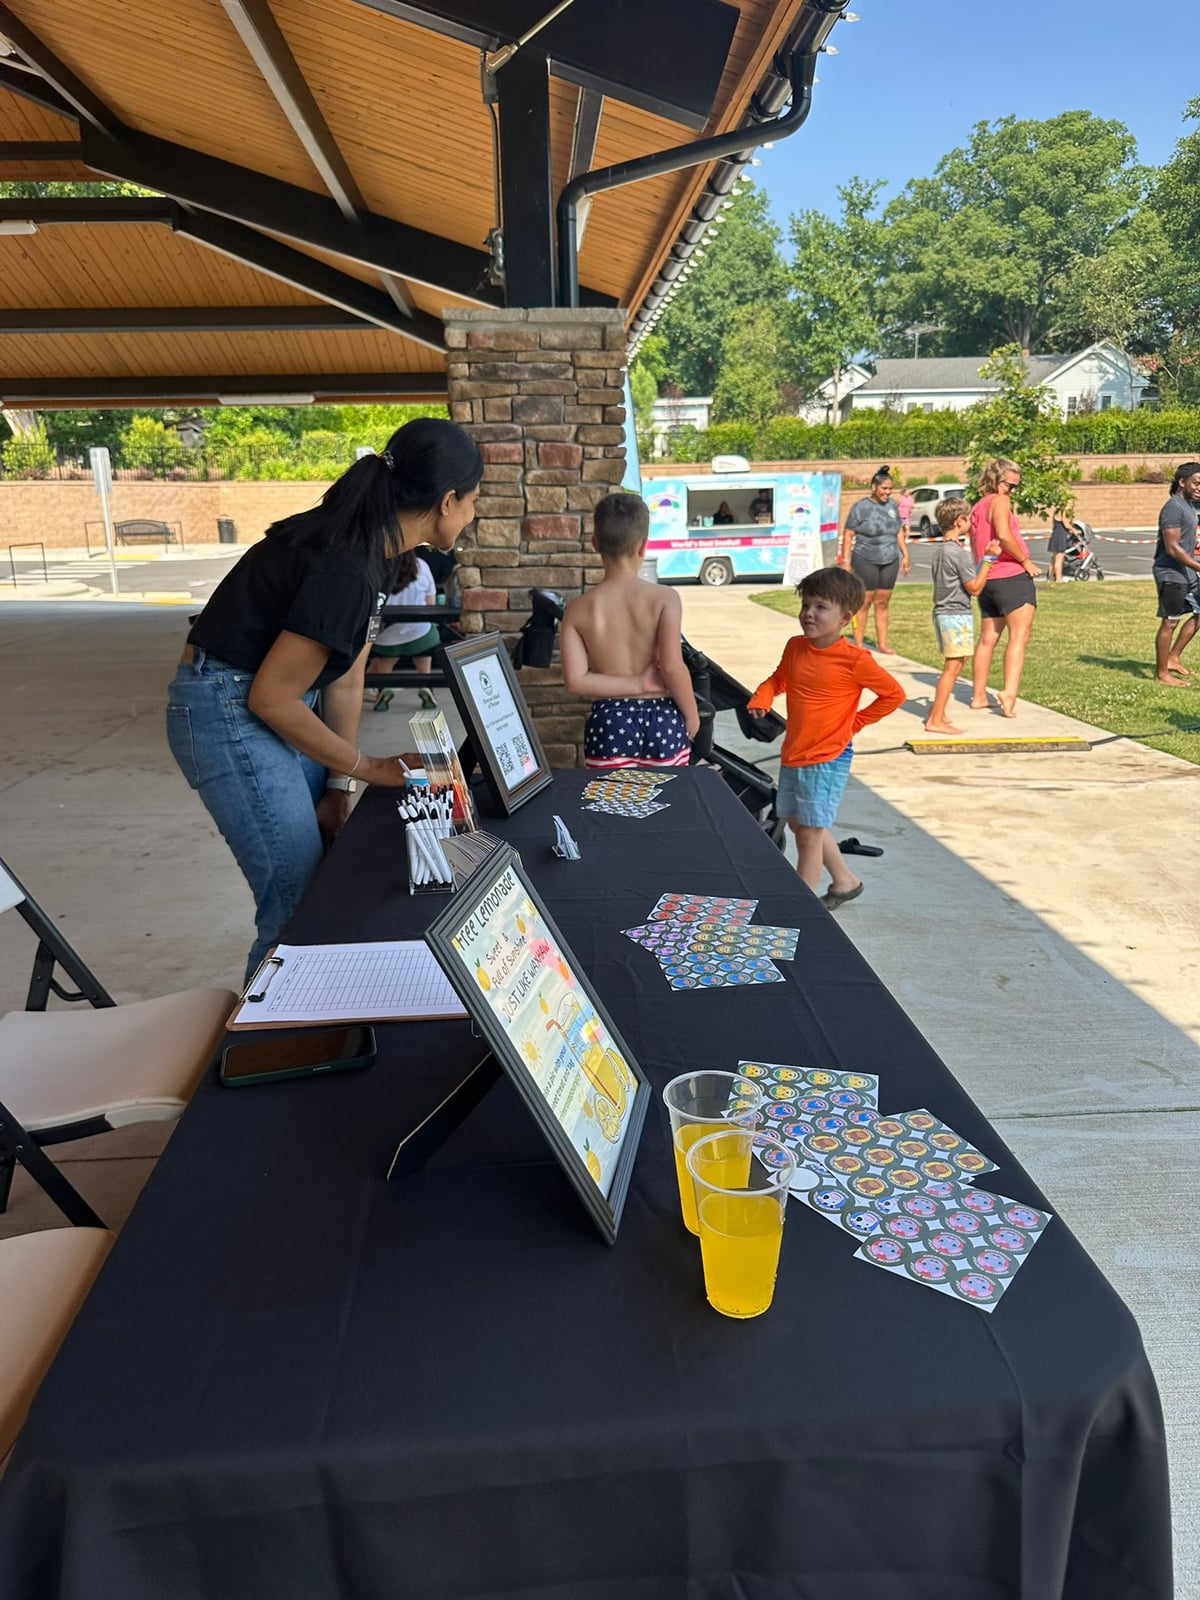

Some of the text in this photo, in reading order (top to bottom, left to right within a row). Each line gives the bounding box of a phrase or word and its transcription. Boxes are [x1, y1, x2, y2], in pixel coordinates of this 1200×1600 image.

[455, 871, 515, 951] Free Lemonade
[485, 940, 502, 965] Sweet
[491, 935, 527, 988] Full of Sunshine
[502, 938, 550, 1023] JUST LIKE WAXHAW
